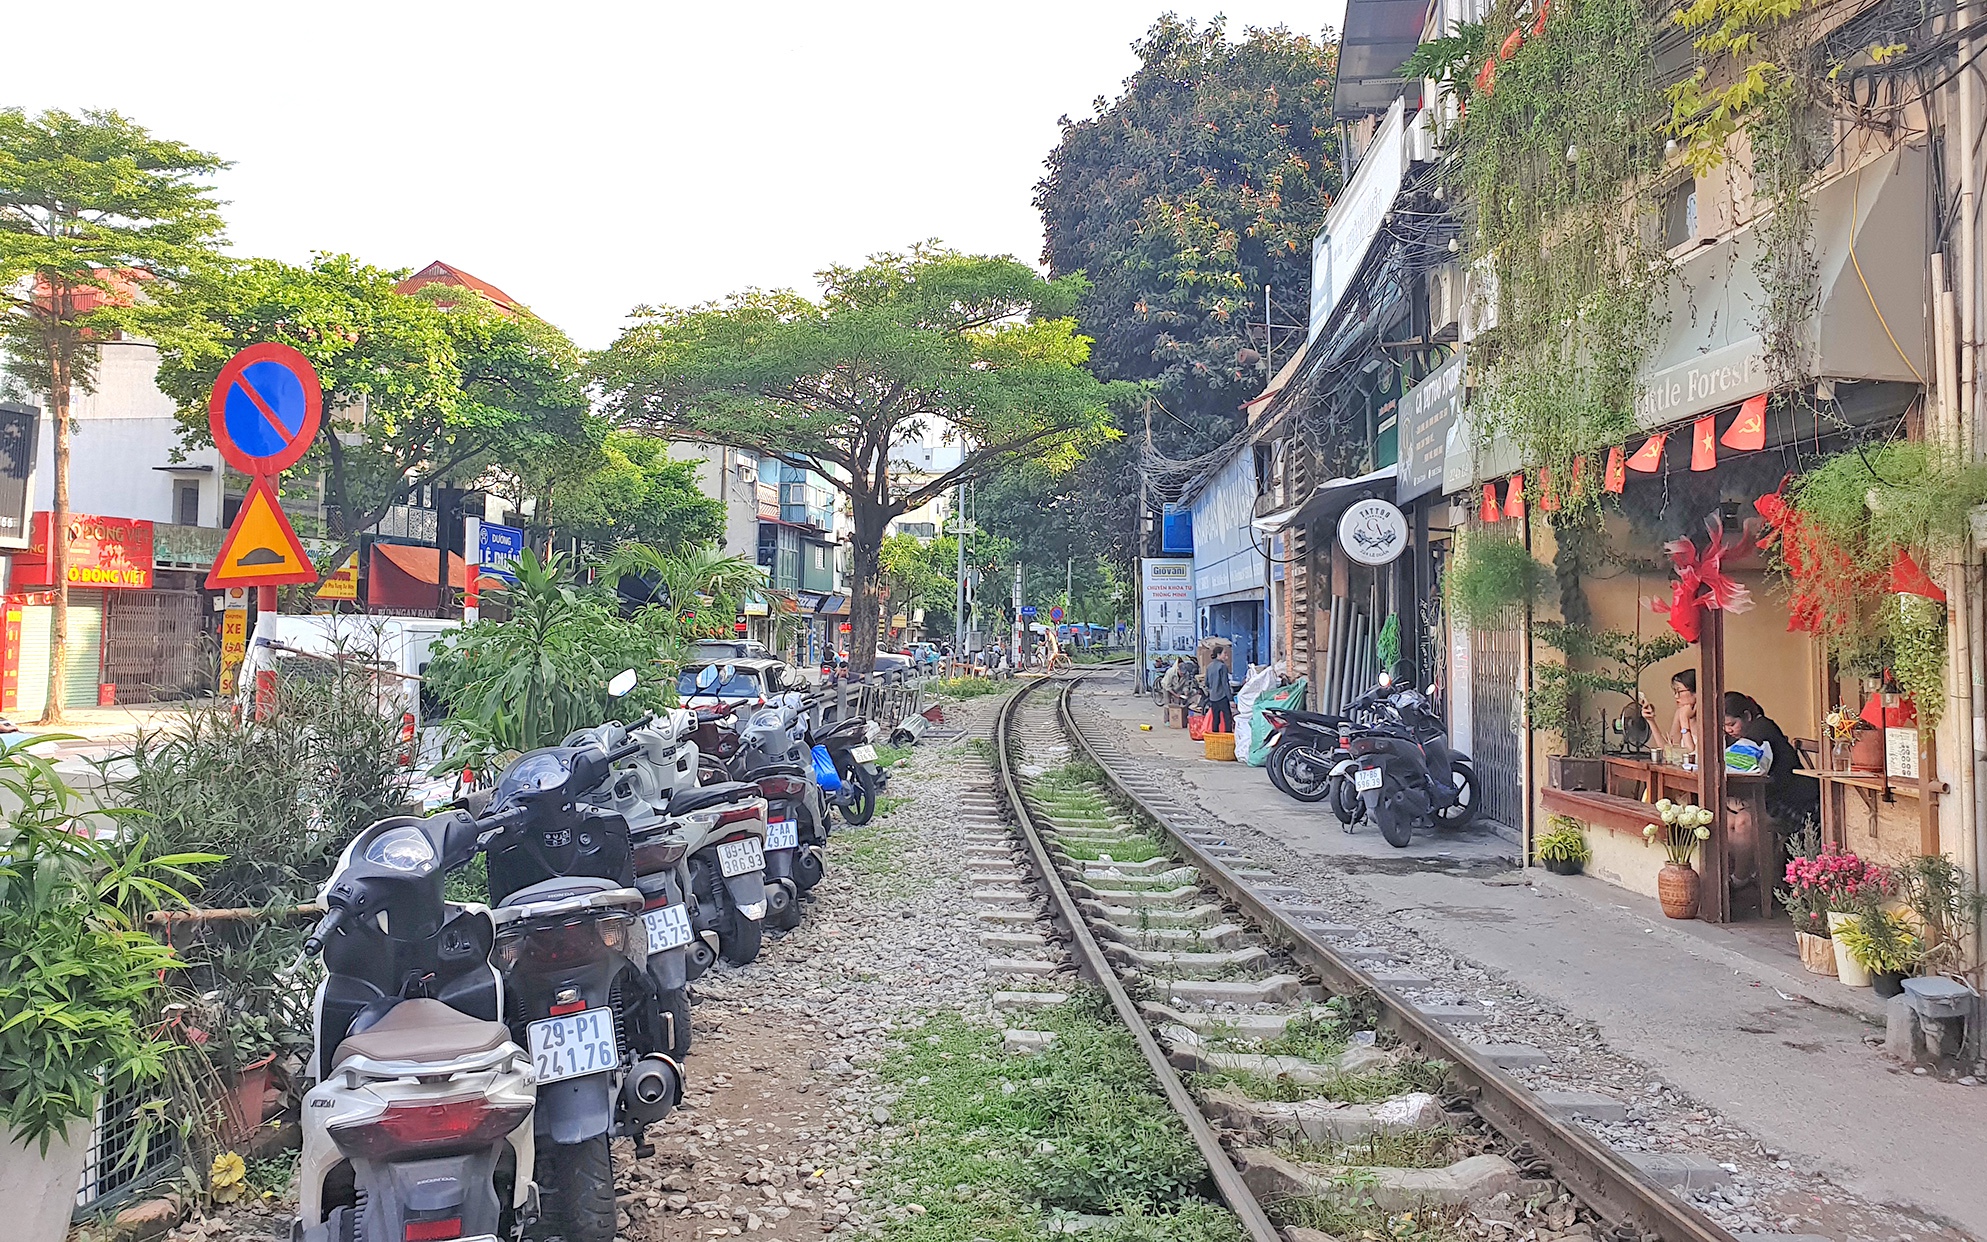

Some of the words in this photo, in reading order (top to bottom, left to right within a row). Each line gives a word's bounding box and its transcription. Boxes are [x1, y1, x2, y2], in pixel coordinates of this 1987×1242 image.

[1687, 354, 1752, 404] Forest
[1359, 507, 1392, 518] TATTOO
[480, 546, 492, 568] LÊ
[1153, 566, 1185, 575] Giovani
[226, 623, 242, 635] XE
[767, 823, 791, 837] 2-AA
[724, 841, 755, 859] 89-L1
[724, 853, 763, 874] 386.93
[547, 891, 576, 899] HONDA
[647, 908, 682, 932] 9-L1
[541, 1014, 600, 1051] 29-P1
[537, 1040, 612, 1080] 241.76
[416, 1176, 458, 1186] HONDA
